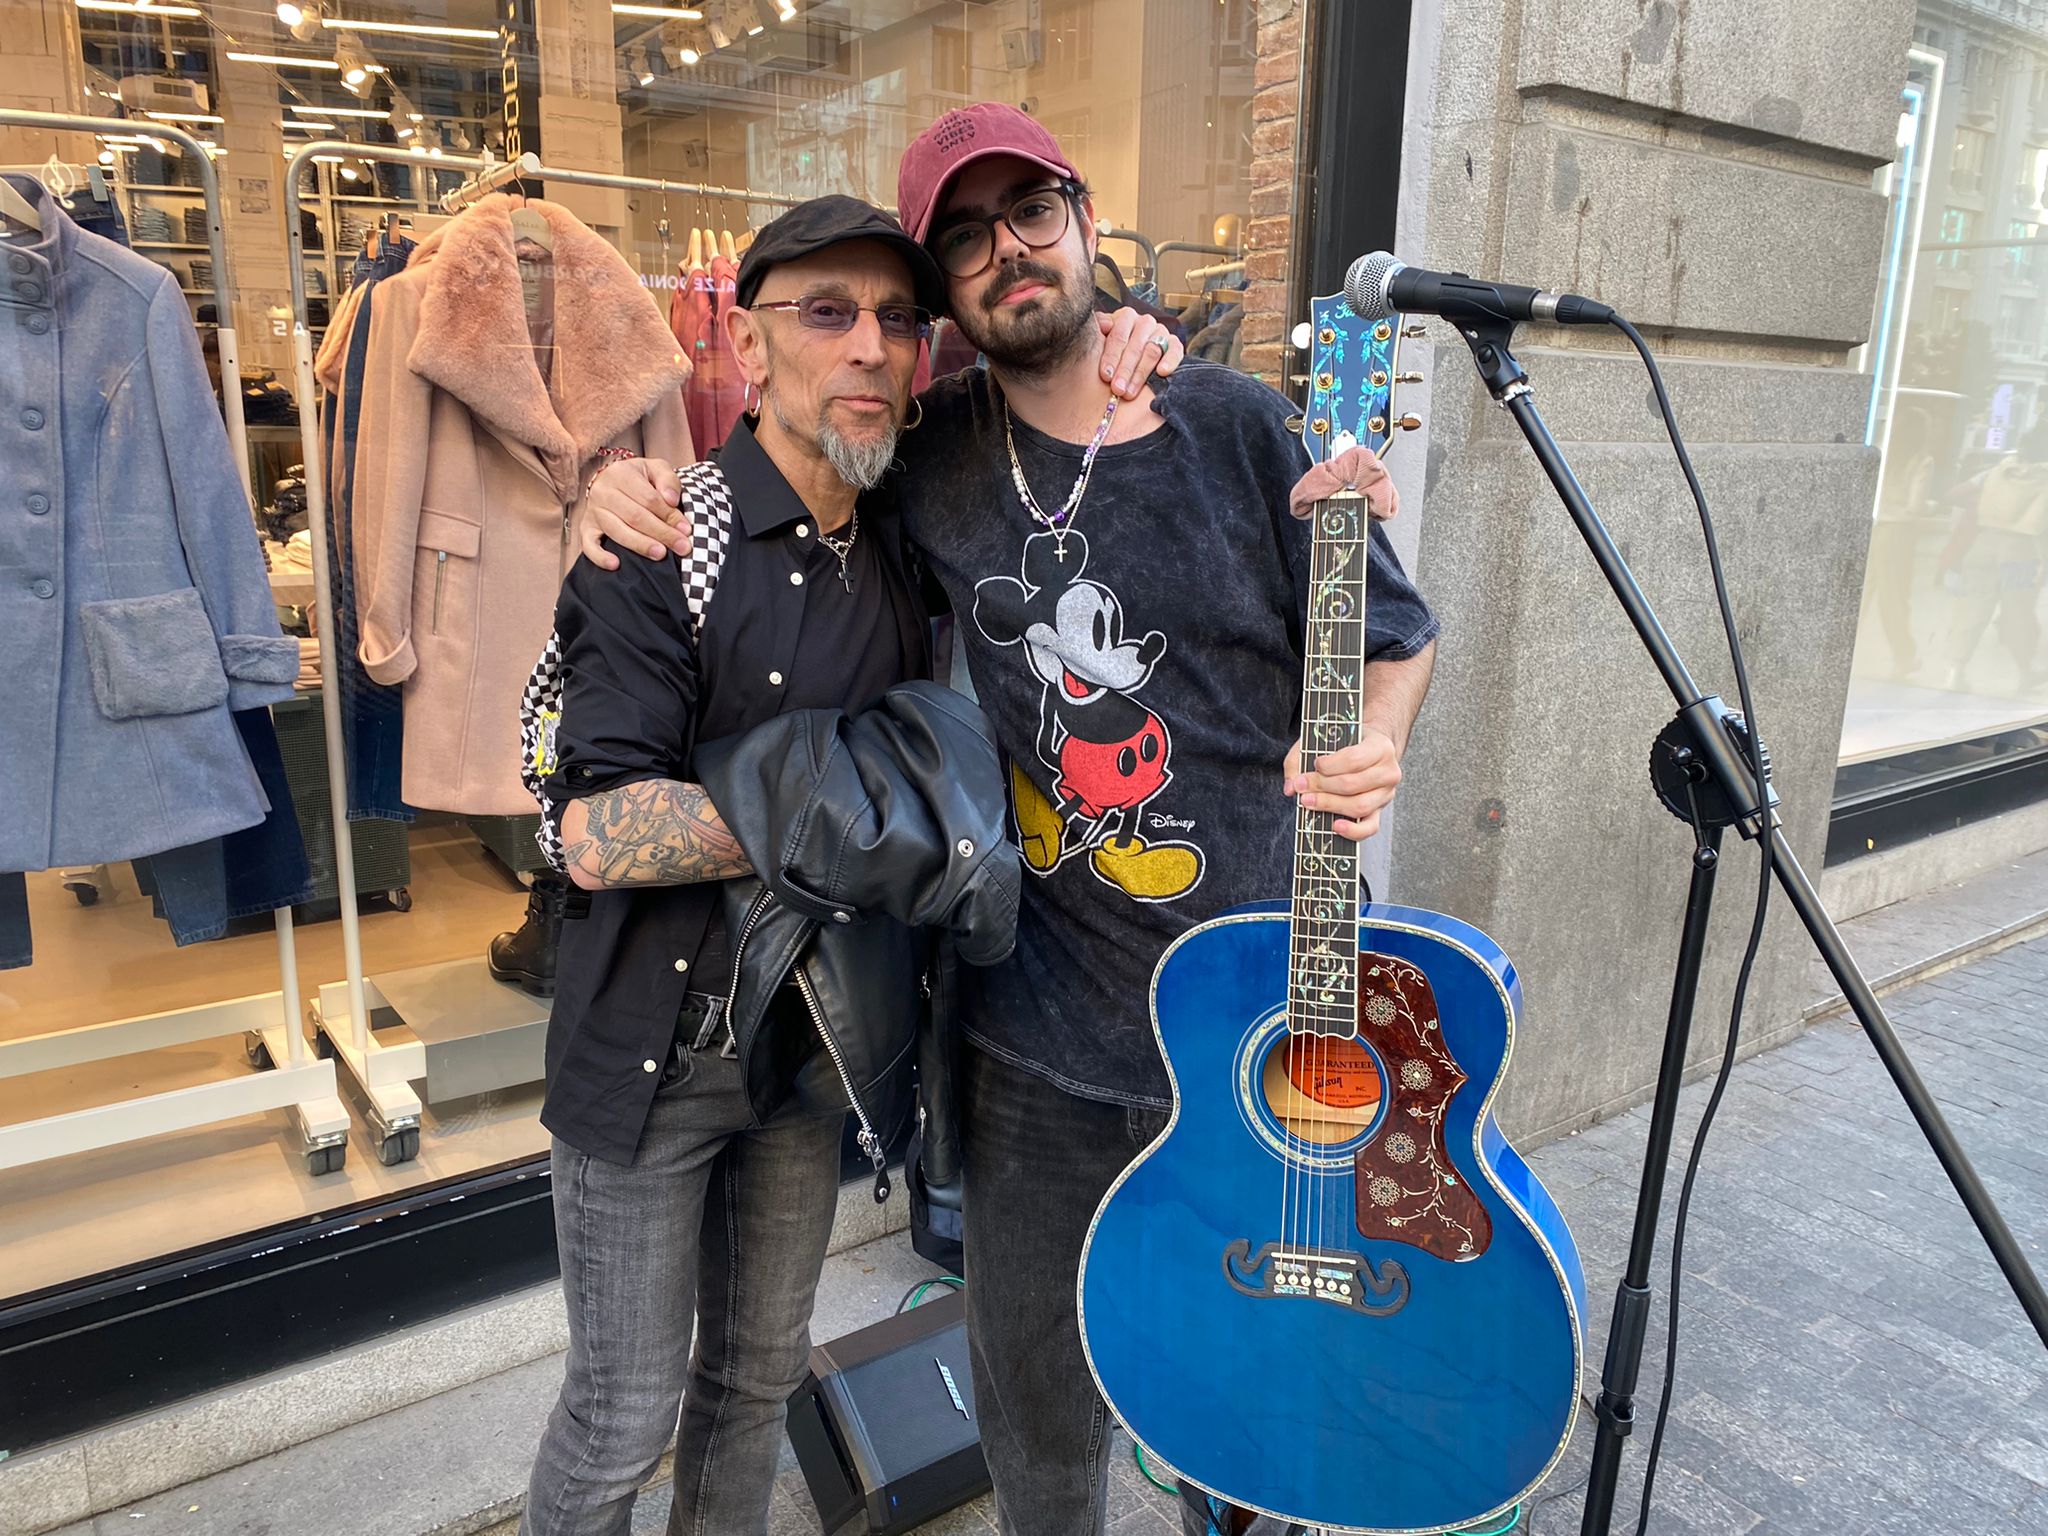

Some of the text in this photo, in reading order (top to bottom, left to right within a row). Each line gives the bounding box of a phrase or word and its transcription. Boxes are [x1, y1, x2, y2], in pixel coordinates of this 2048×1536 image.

[937, 123, 975, 146] VIBES
[940, 131, 976, 153] ONLY
[1148, 812, 1196, 833] Disney
[1305, 1058, 1375, 1069] GUARANTEED
[935, 1357, 970, 1421] BOSE
